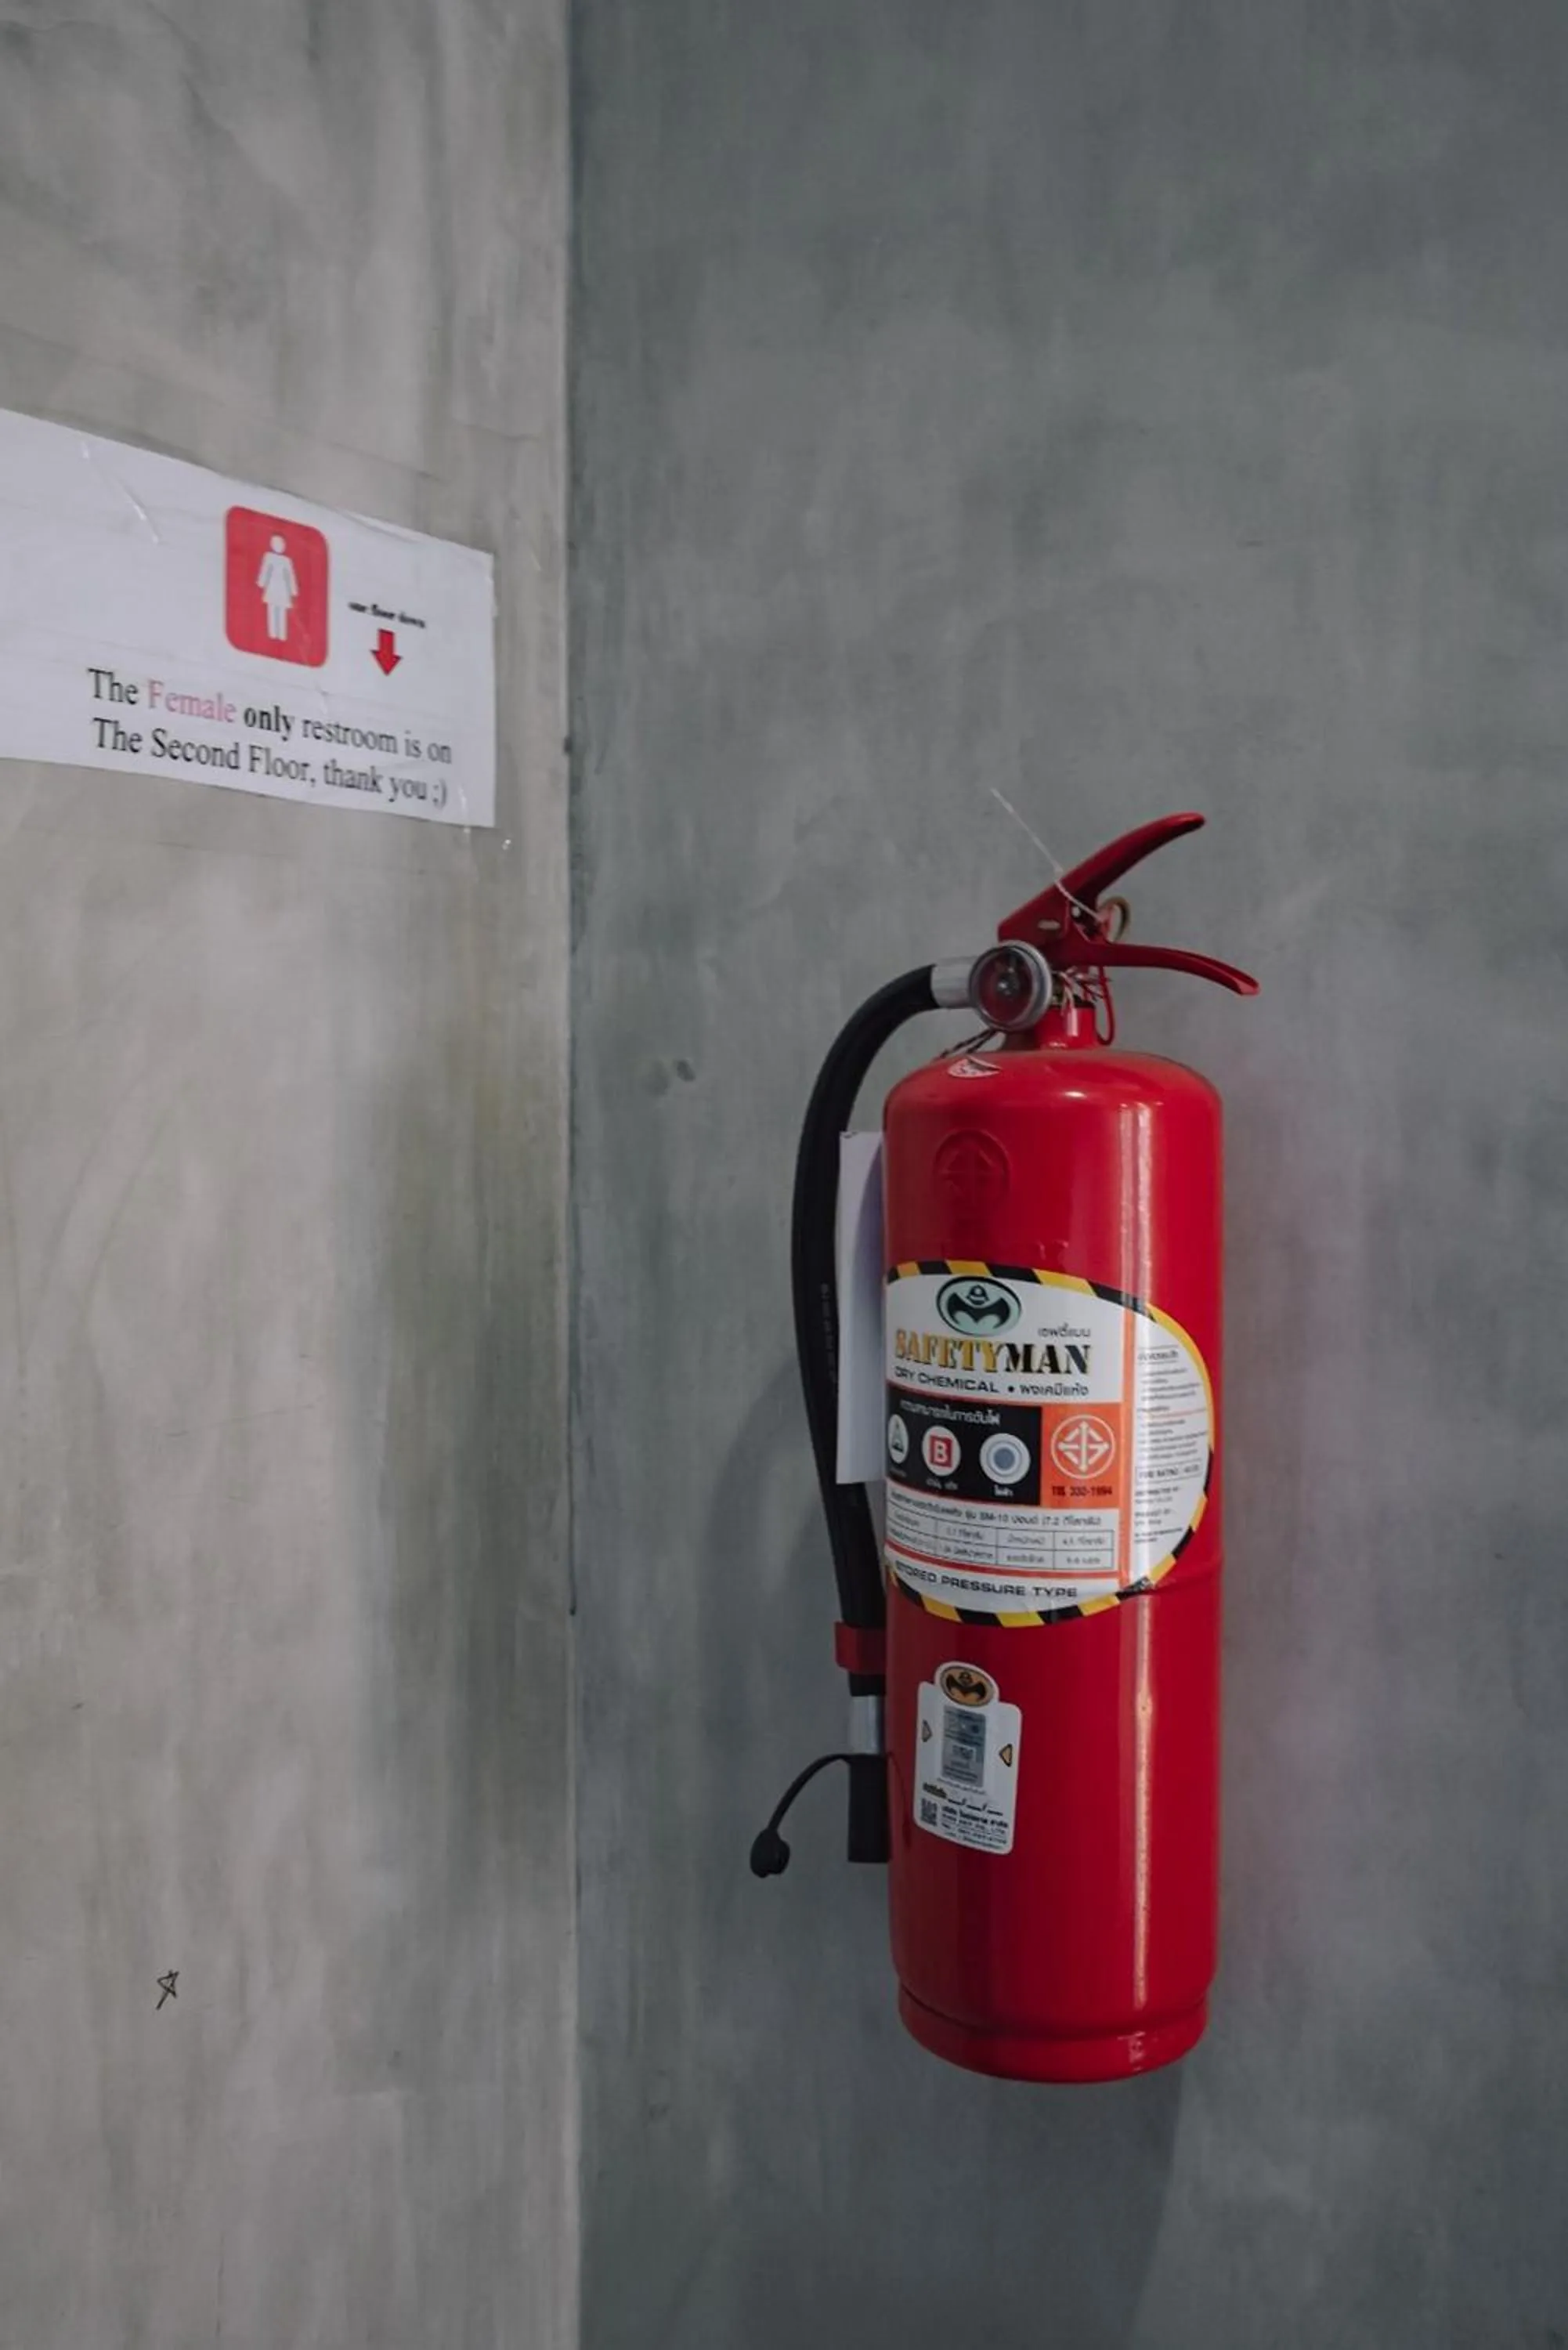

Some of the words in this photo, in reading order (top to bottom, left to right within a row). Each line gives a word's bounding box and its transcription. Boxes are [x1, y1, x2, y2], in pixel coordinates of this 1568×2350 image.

[88, 668, 139, 705] The
[148, 678, 237, 723] Female
[244, 705, 295, 742] only
[302, 718, 399, 754] restroom
[404, 730, 422, 758] is
[428, 743, 452, 765] on
[92, 717, 143, 754] The
[150, 728, 241, 770] Second
[323, 758, 383, 794] thank
[388, 776, 428, 803] you
[894, 1328, 1091, 1376] SAFETYMAN
[894, 1365, 915, 1379] DRY
[918, 1372, 1000, 1394] CHEMICAL
[934, 1440, 948, 1464] B
[894, 1560, 937, 1583] STORED
[941, 1575, 1026, 1596] PRESSURE
[1032, 1586, 1078, 1598] TYPE
